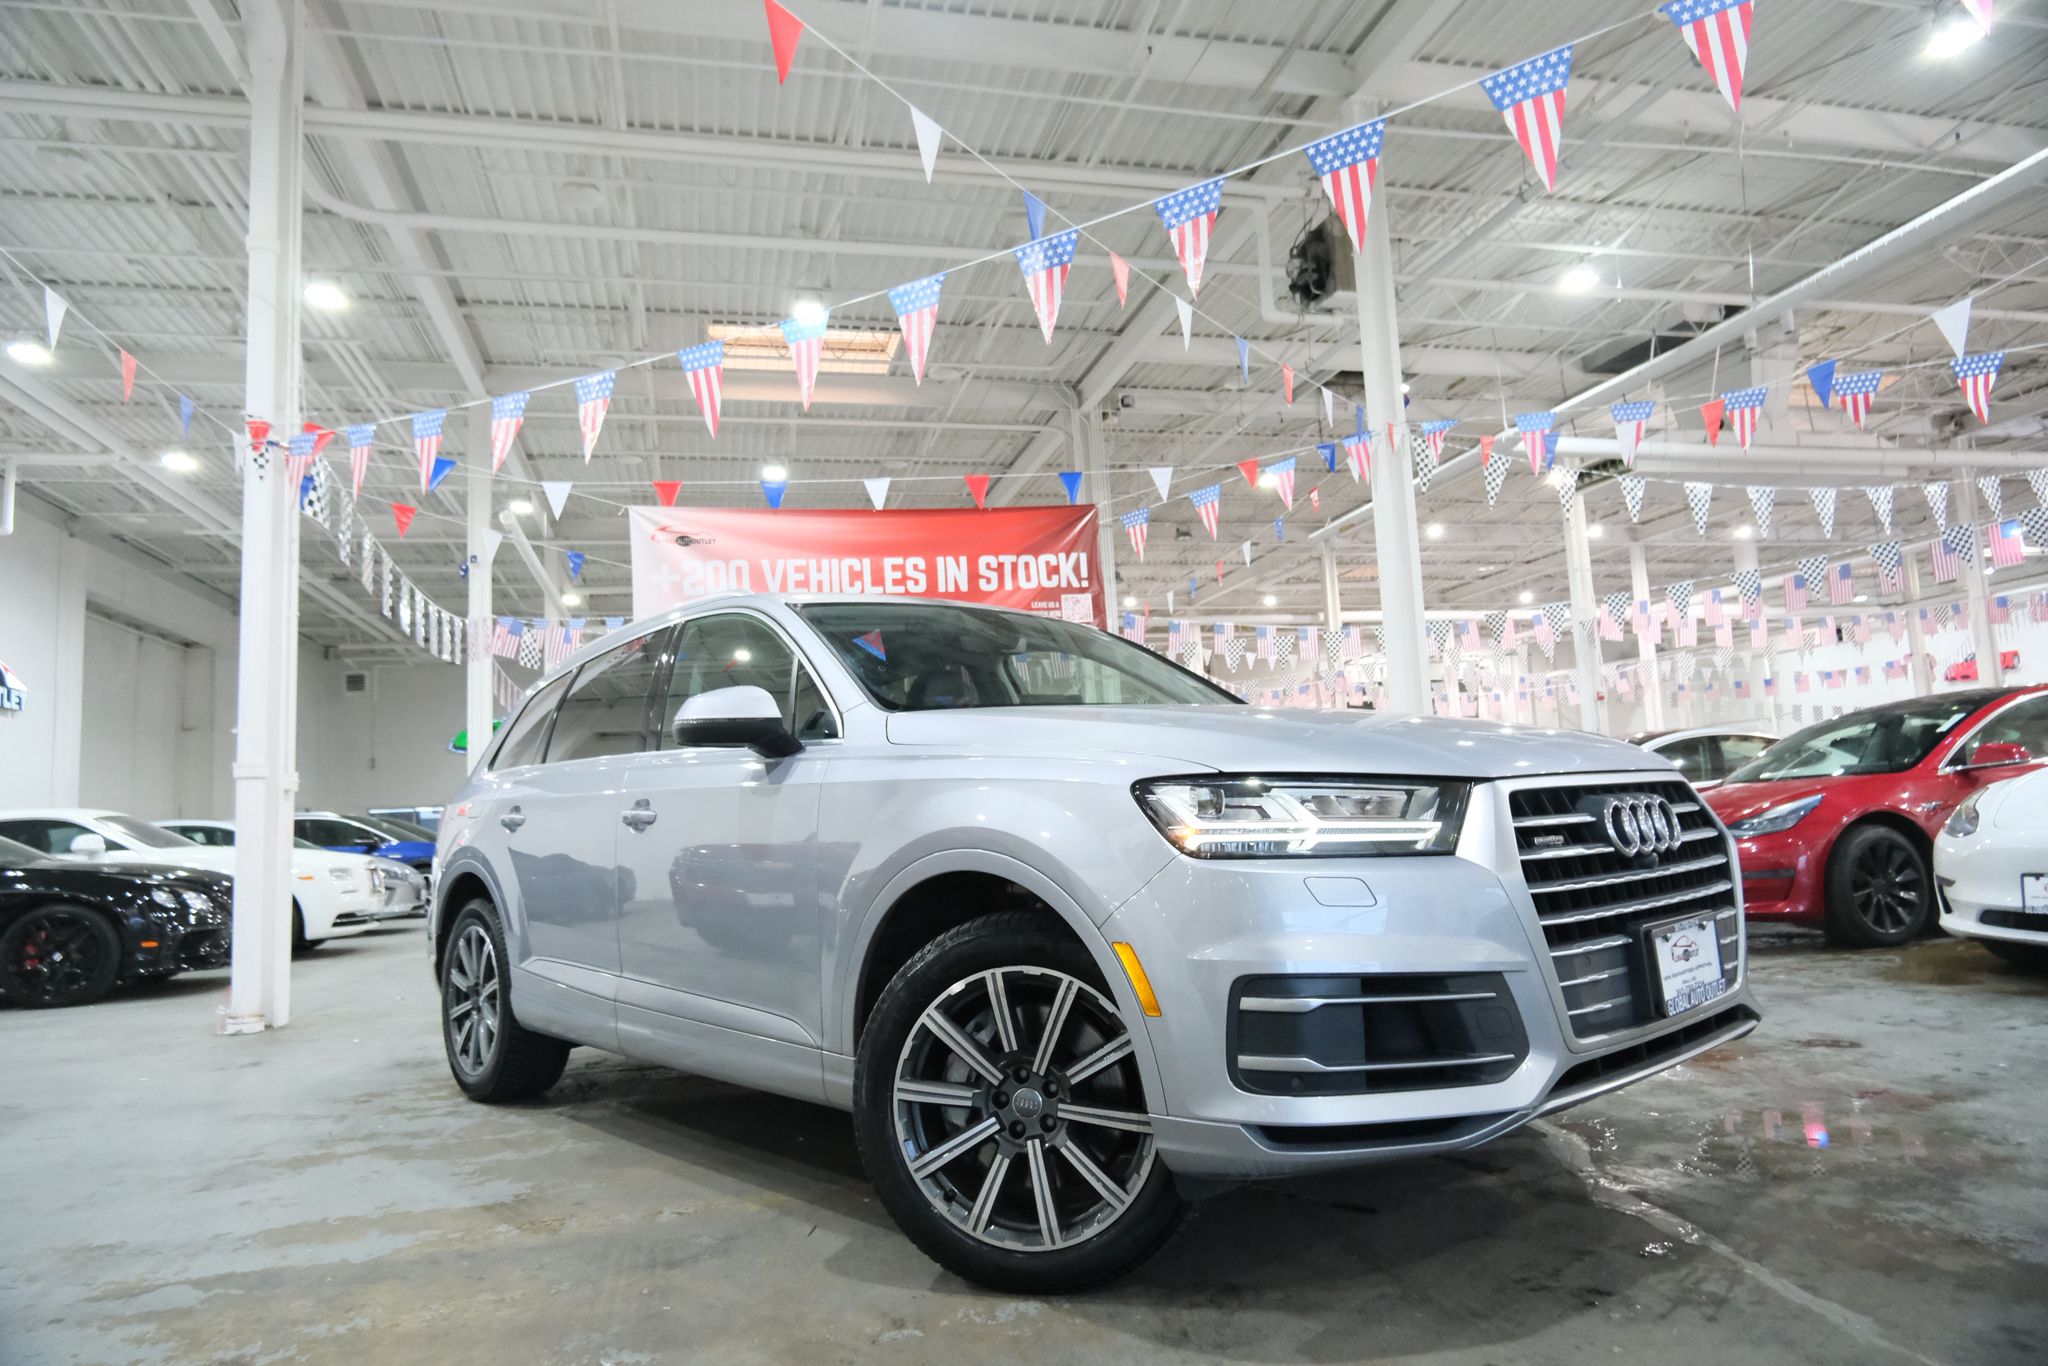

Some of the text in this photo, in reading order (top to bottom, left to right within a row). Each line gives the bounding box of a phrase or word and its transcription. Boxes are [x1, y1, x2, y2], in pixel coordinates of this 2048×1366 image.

[761, 556, 927, 594] VEHICLES
[936, 555, 969, 593] IN
[978, 552, 1089, 592] STOCK!
[1031, 601, 1048, 609] LEAVE
[1667, 993, 1691, 1016] GLOBAL
[1691, 986, 1705, 1007] AUTO
[1705, 979, 1726, 1000] OUTLET
